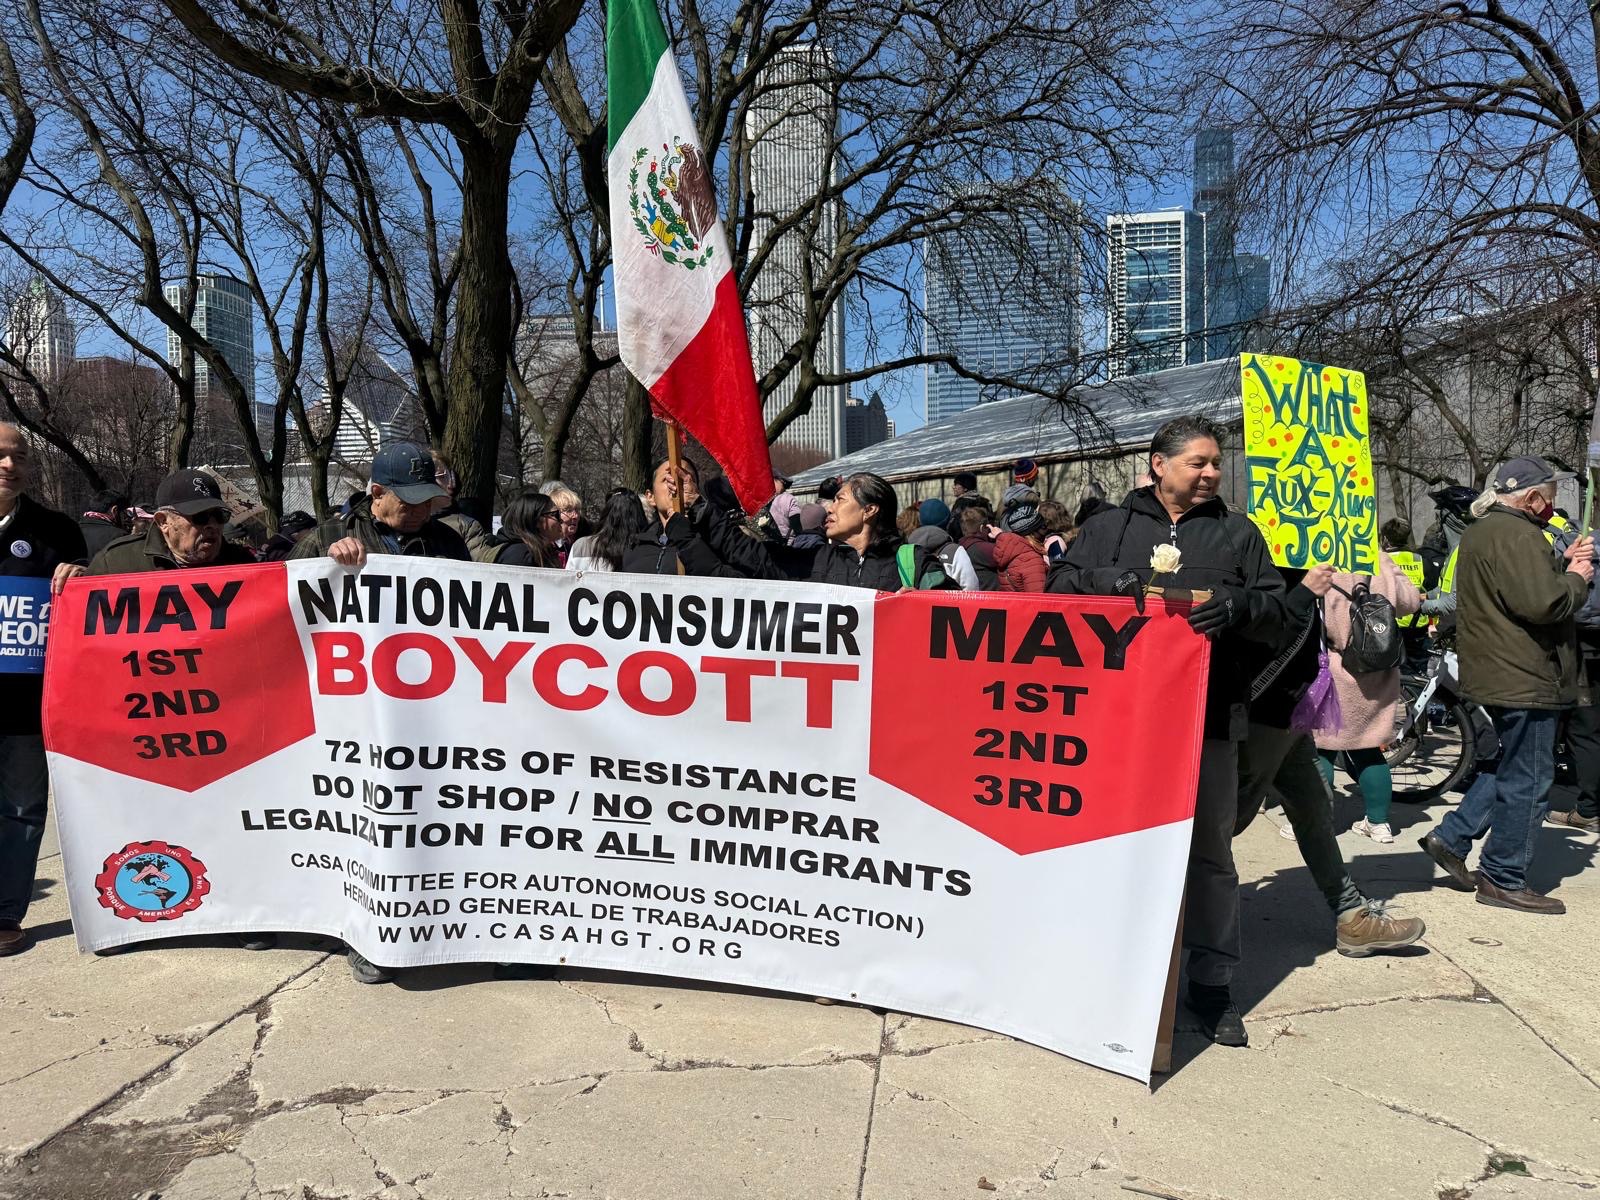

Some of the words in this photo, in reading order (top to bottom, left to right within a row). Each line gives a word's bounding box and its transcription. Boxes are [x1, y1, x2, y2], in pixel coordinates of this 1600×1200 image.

[1283, 423, 1332, 472] A
[1278, 510, 1375, 576] JOKE
[83, 580, 244, 636] MAY
[297, 574, 549, 634] NATIONAL
[568, 587, 861, 656] CONSUMER
[122, 648, 203, 677] 1ST
[929, 605, 1152, 671] MAY
[124, 688, 221, 719] 2ND
[311, 631, 859, 729] BOYCOTT
[982, 680, 1088, 716] 1ST
[132, 729, 227, 760] 3RD
[972, 728, 1088, 766] 2ND
[324, 739, 361, 764] 72
[370, 744, 506, 771] HOURS
[521, 750, 575, 776] OF
[590, 755, 856, 802] RESISTANCE
[312, 774, 354, 799] DO
[363, 779, 423, 811] NOT
[437, 784, 556, 812] SHOP
[568, 790, 580, 815] /
[593, 792, 653, 820] NO
[667, 800, 880, 844] COMPRAR
[973, 774, 1083, 817] 3RD
[114, 848, 140, 866] SOMOS
[165, 848, 182, 858] UNO
[241, 808, 484, 849] LEGALIZATION
[500, 824, 584, 852] FOR
[596, 830, 675, 859] ALL
[690, 838, 972, 897] IMMIGRANTS
[105, 886, 127, 911] PORQUE
[185, 898, 195, 906] ES
[290, 852, 343, 872] CASA
[346, 858, 455, 893] (COMMITTEE
[463, 872, 517, 890] FOR
[524, 874, 706, 905] AUTONOMOUS
[714, 890, 808, 917] SOCIAL
[814, 903, 925, 938] ACTION)
[343, 881, 451, 918] HERMANDAD
[459, 897, 583, 918] GENERAL
[591, 903, 624, 922] DE
[632, 906, 841, 948] TRABAJADORES
